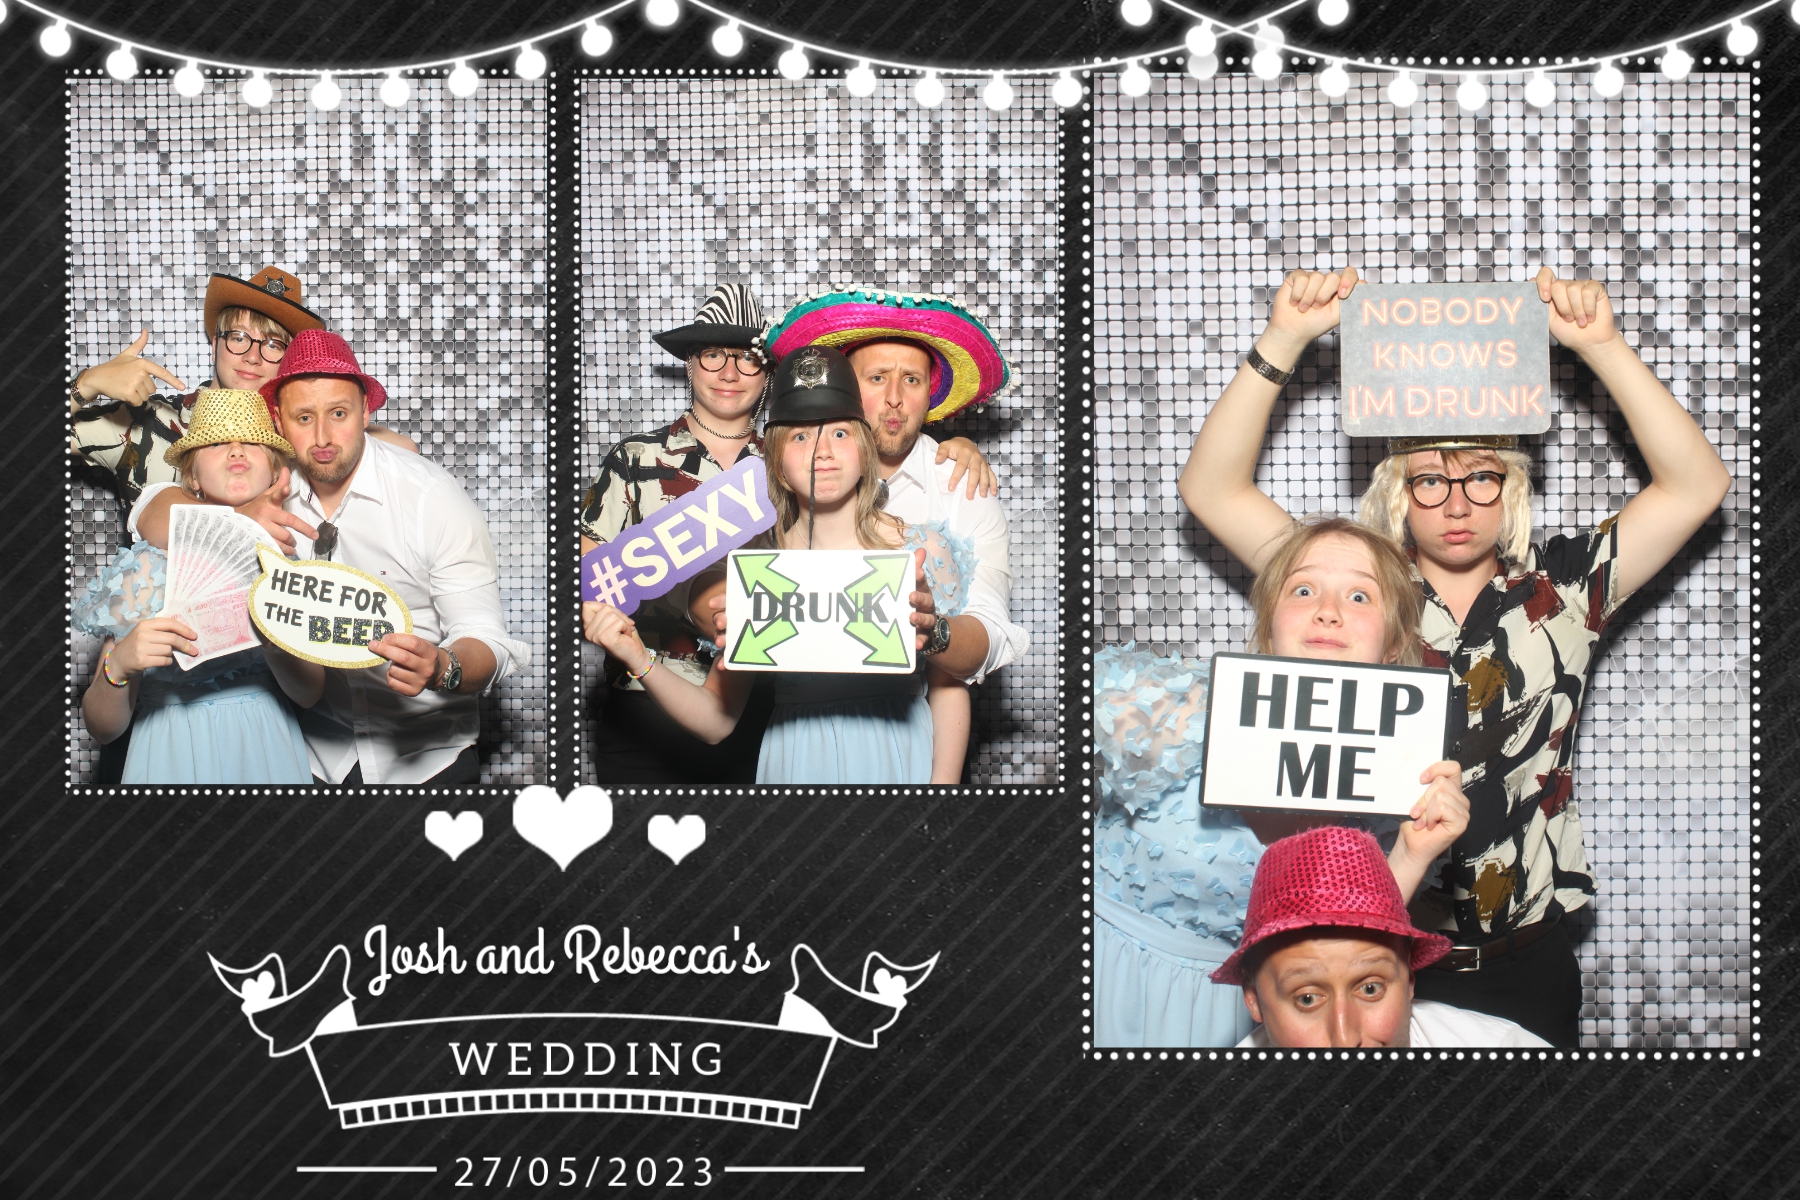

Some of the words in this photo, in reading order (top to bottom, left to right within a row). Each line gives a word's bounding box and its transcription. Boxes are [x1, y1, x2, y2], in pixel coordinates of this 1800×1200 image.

[1362, 296, 1523, 326] NOBODY
[1373, 339, 1518, 370] KNOWS
[1349, 384, 1395, 418] I'M
[1405, 384, 1545, 418] DRUNK
[589, 468, 765, 608] #SEXY
[271, 568, 335, 604] HERE
[339, 585, 388, 618] FOR
[752, 591, 889, 623] DRUNK
[264, 602, 304, 626] THE
[1239, 671, 1424, 737] HELP
[1276, 741, 1376, 802] ME
